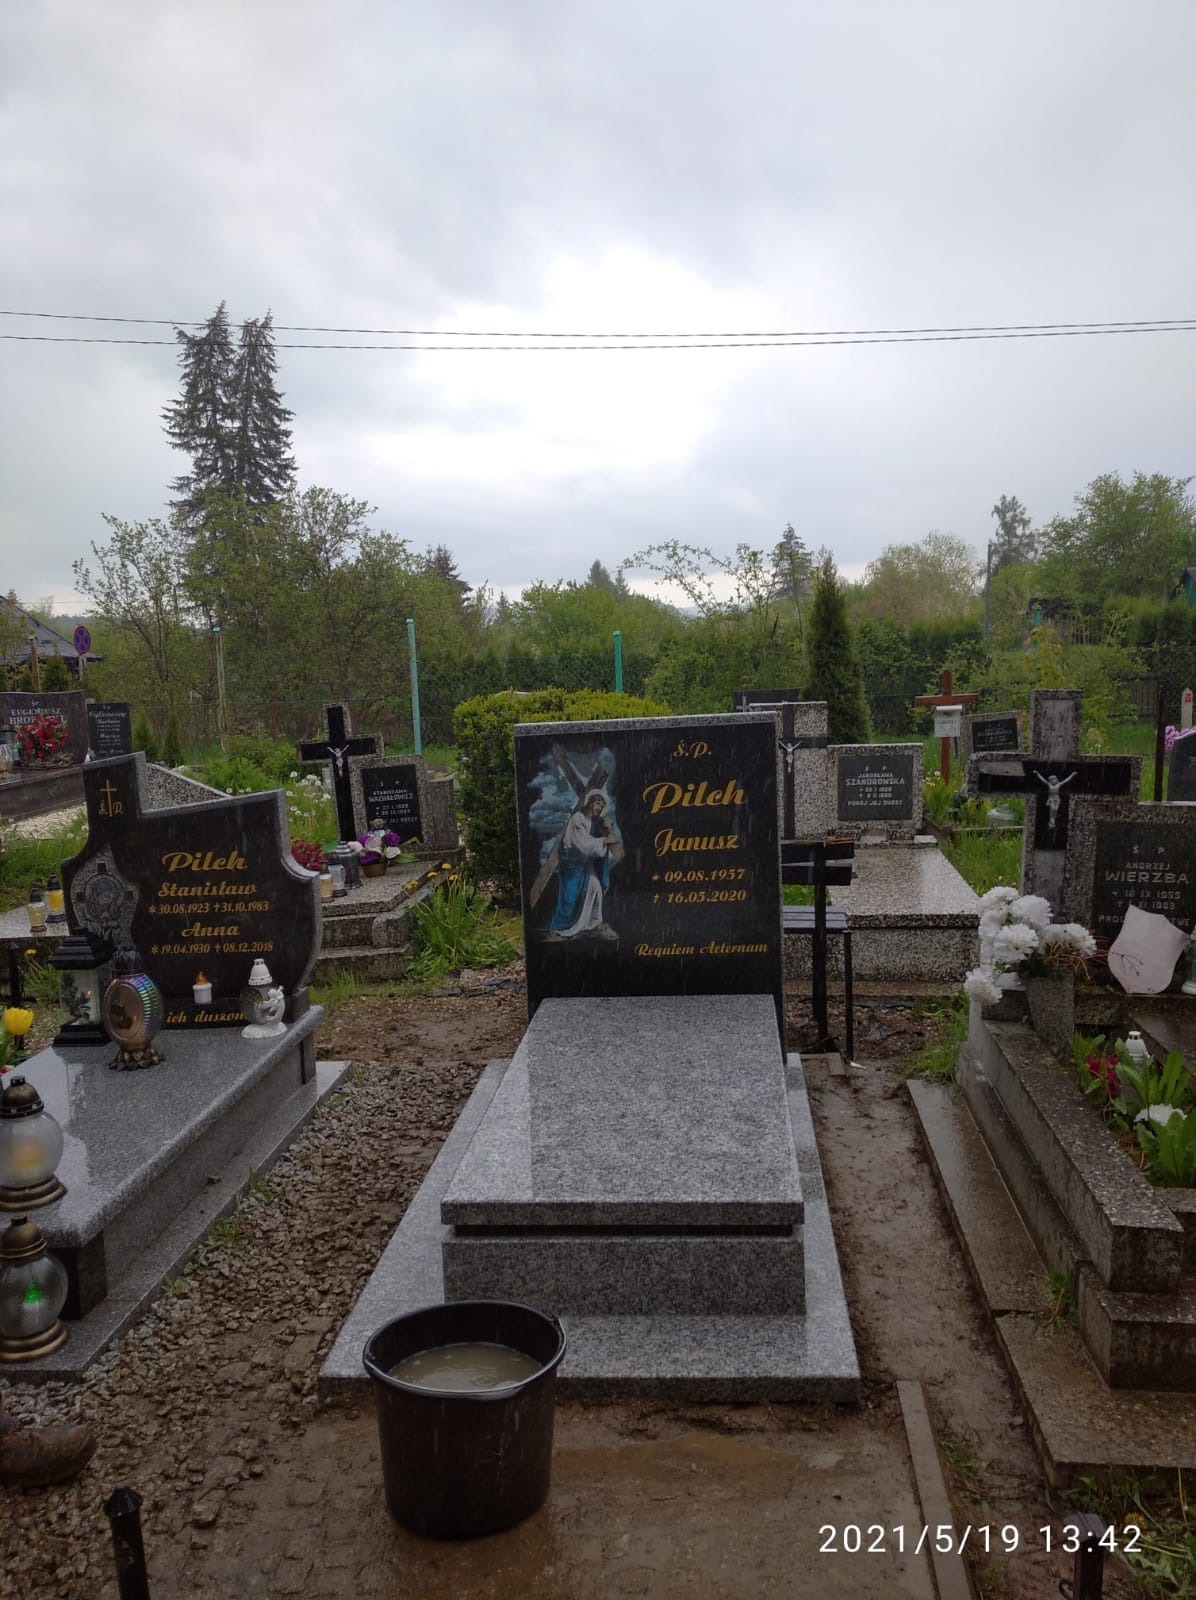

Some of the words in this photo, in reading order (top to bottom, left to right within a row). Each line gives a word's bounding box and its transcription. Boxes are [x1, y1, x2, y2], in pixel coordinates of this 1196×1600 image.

[642, 779, 748, 814] Pilch
[654, 828, 739, 856] Janusz
[162, 850, 248, 873] Pilch
[1125, 861, 1170, 870] ANDRZEJ
[664, 868, 746, 883] 09.08.1957
[1104, 870, 1190, 885] WIERZBA
[667, 888, 748, 904] 16.05.2020
[181, 922, 240, 937] Anna
[634, 943, 694, 958] Requiem
